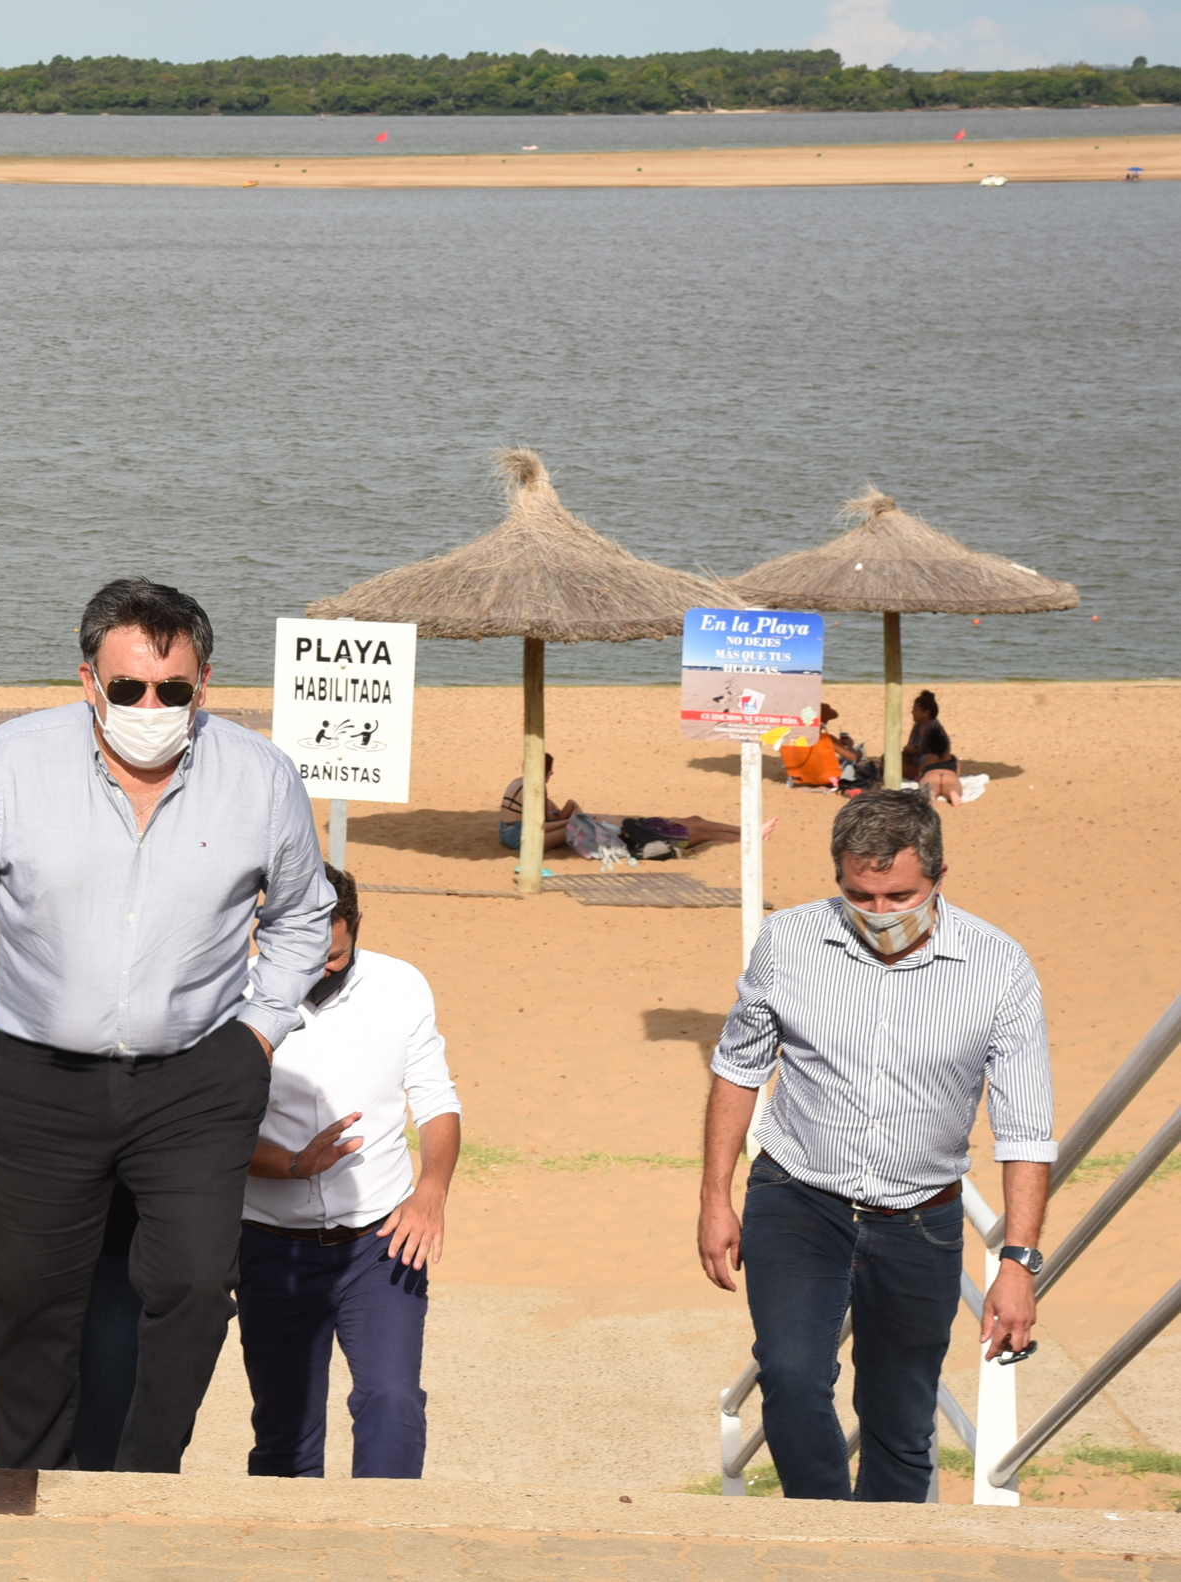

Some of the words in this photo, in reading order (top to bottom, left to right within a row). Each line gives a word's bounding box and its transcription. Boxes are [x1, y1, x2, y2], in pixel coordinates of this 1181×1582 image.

[700, 614, 727, 631] En
[732, 616, 749, 632] la
[755, 617, 809, 640] Playa
[296, 637, 392, 665] PLAYA
[726, 636, 743, 645] NO
[744, 637, 781, 648] DEJES
[715, 647, 739, 660] MÁS
[741, 651, 766, 662] QUE
[768, 651, 791, 662] TUS
[294, 675, 392, 704] HABILITADA
[700, 713, 742, 722] CUIDEMOS
[743, 714, 780, 724] NUESTRO
[300, 760, 381, 784] BAÑISTAS
